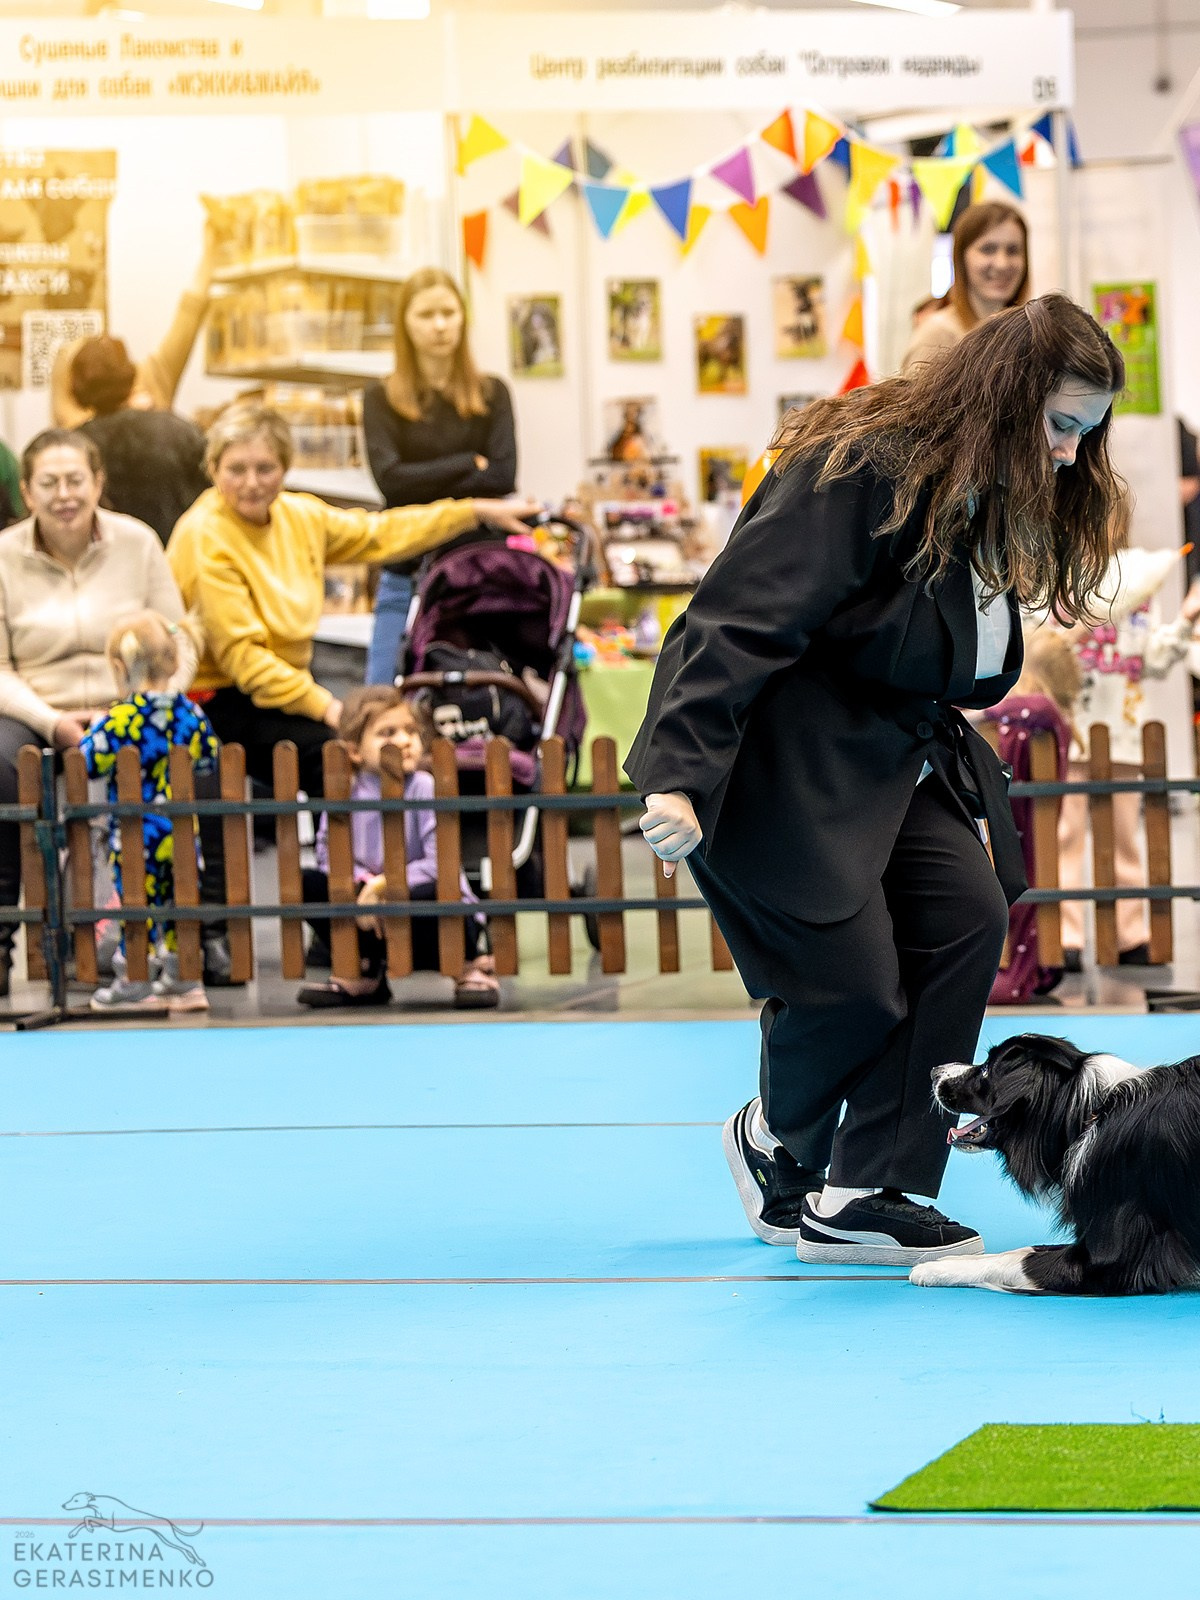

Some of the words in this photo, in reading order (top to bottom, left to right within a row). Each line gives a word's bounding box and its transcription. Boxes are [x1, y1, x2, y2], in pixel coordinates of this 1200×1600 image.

[19, 34, 109, 66] Сушеные
[119, 33, 220, 59] Лакомства
[230, 38, 243, 58] и
[530, 53, 587, 84] Центр
[735, 50, 788, 79] собак
[52, 77, 87, 100] для
[99, 70, 153, 98] собак
